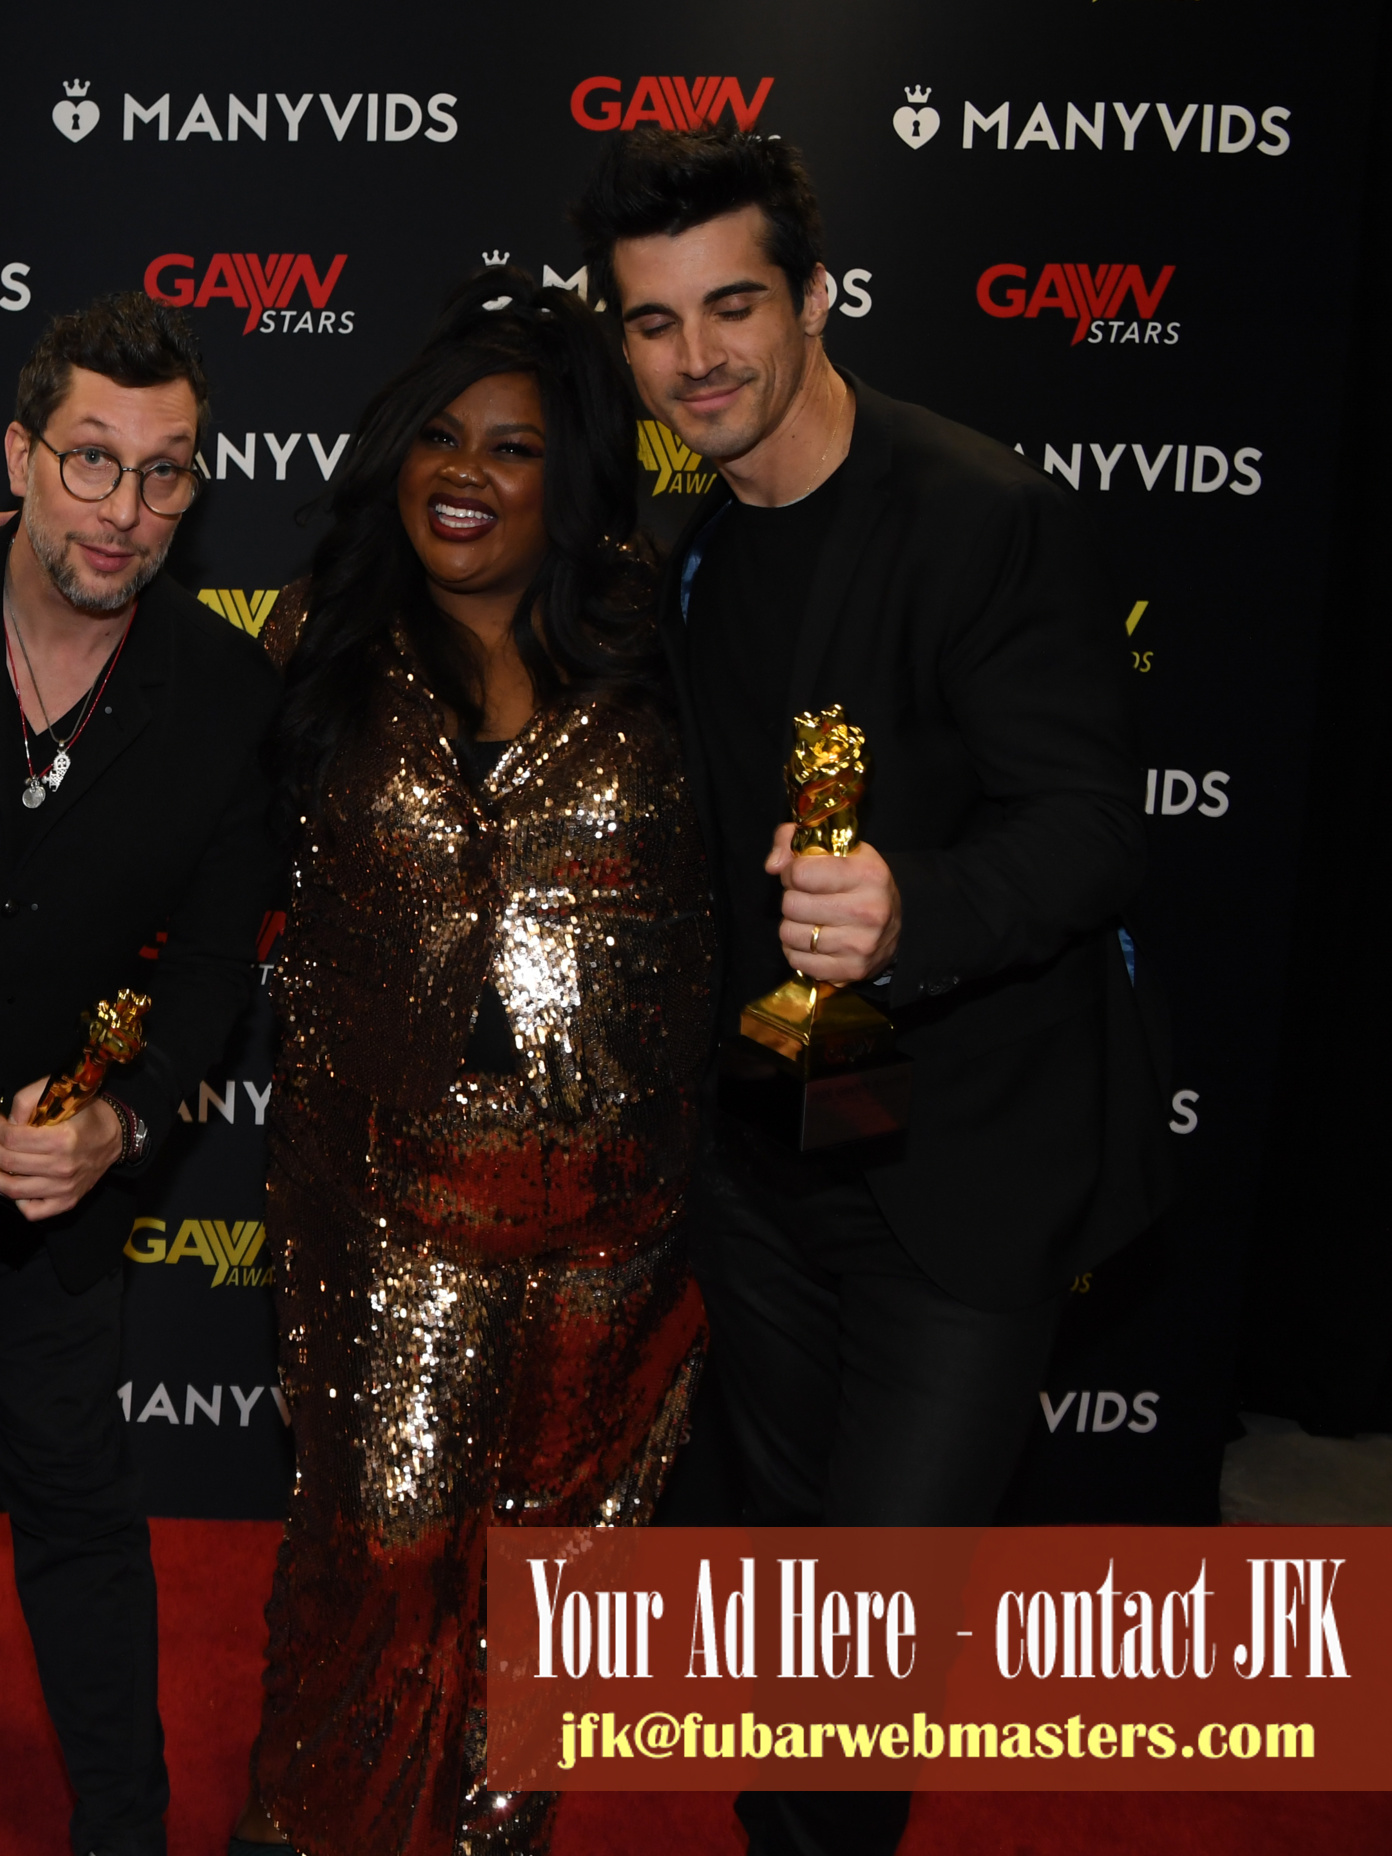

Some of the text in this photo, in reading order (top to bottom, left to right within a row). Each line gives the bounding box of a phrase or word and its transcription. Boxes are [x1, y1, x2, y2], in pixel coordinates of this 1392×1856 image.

[123, 93, 458, 143] MANYVIDS
[962, 101, 1292, 156] MANYVIDS
[259, 310, 355, 333] STARS
[1087, 320, 1180, 344] STARS
[1014, 442, 1263, 495] NYVIDS
